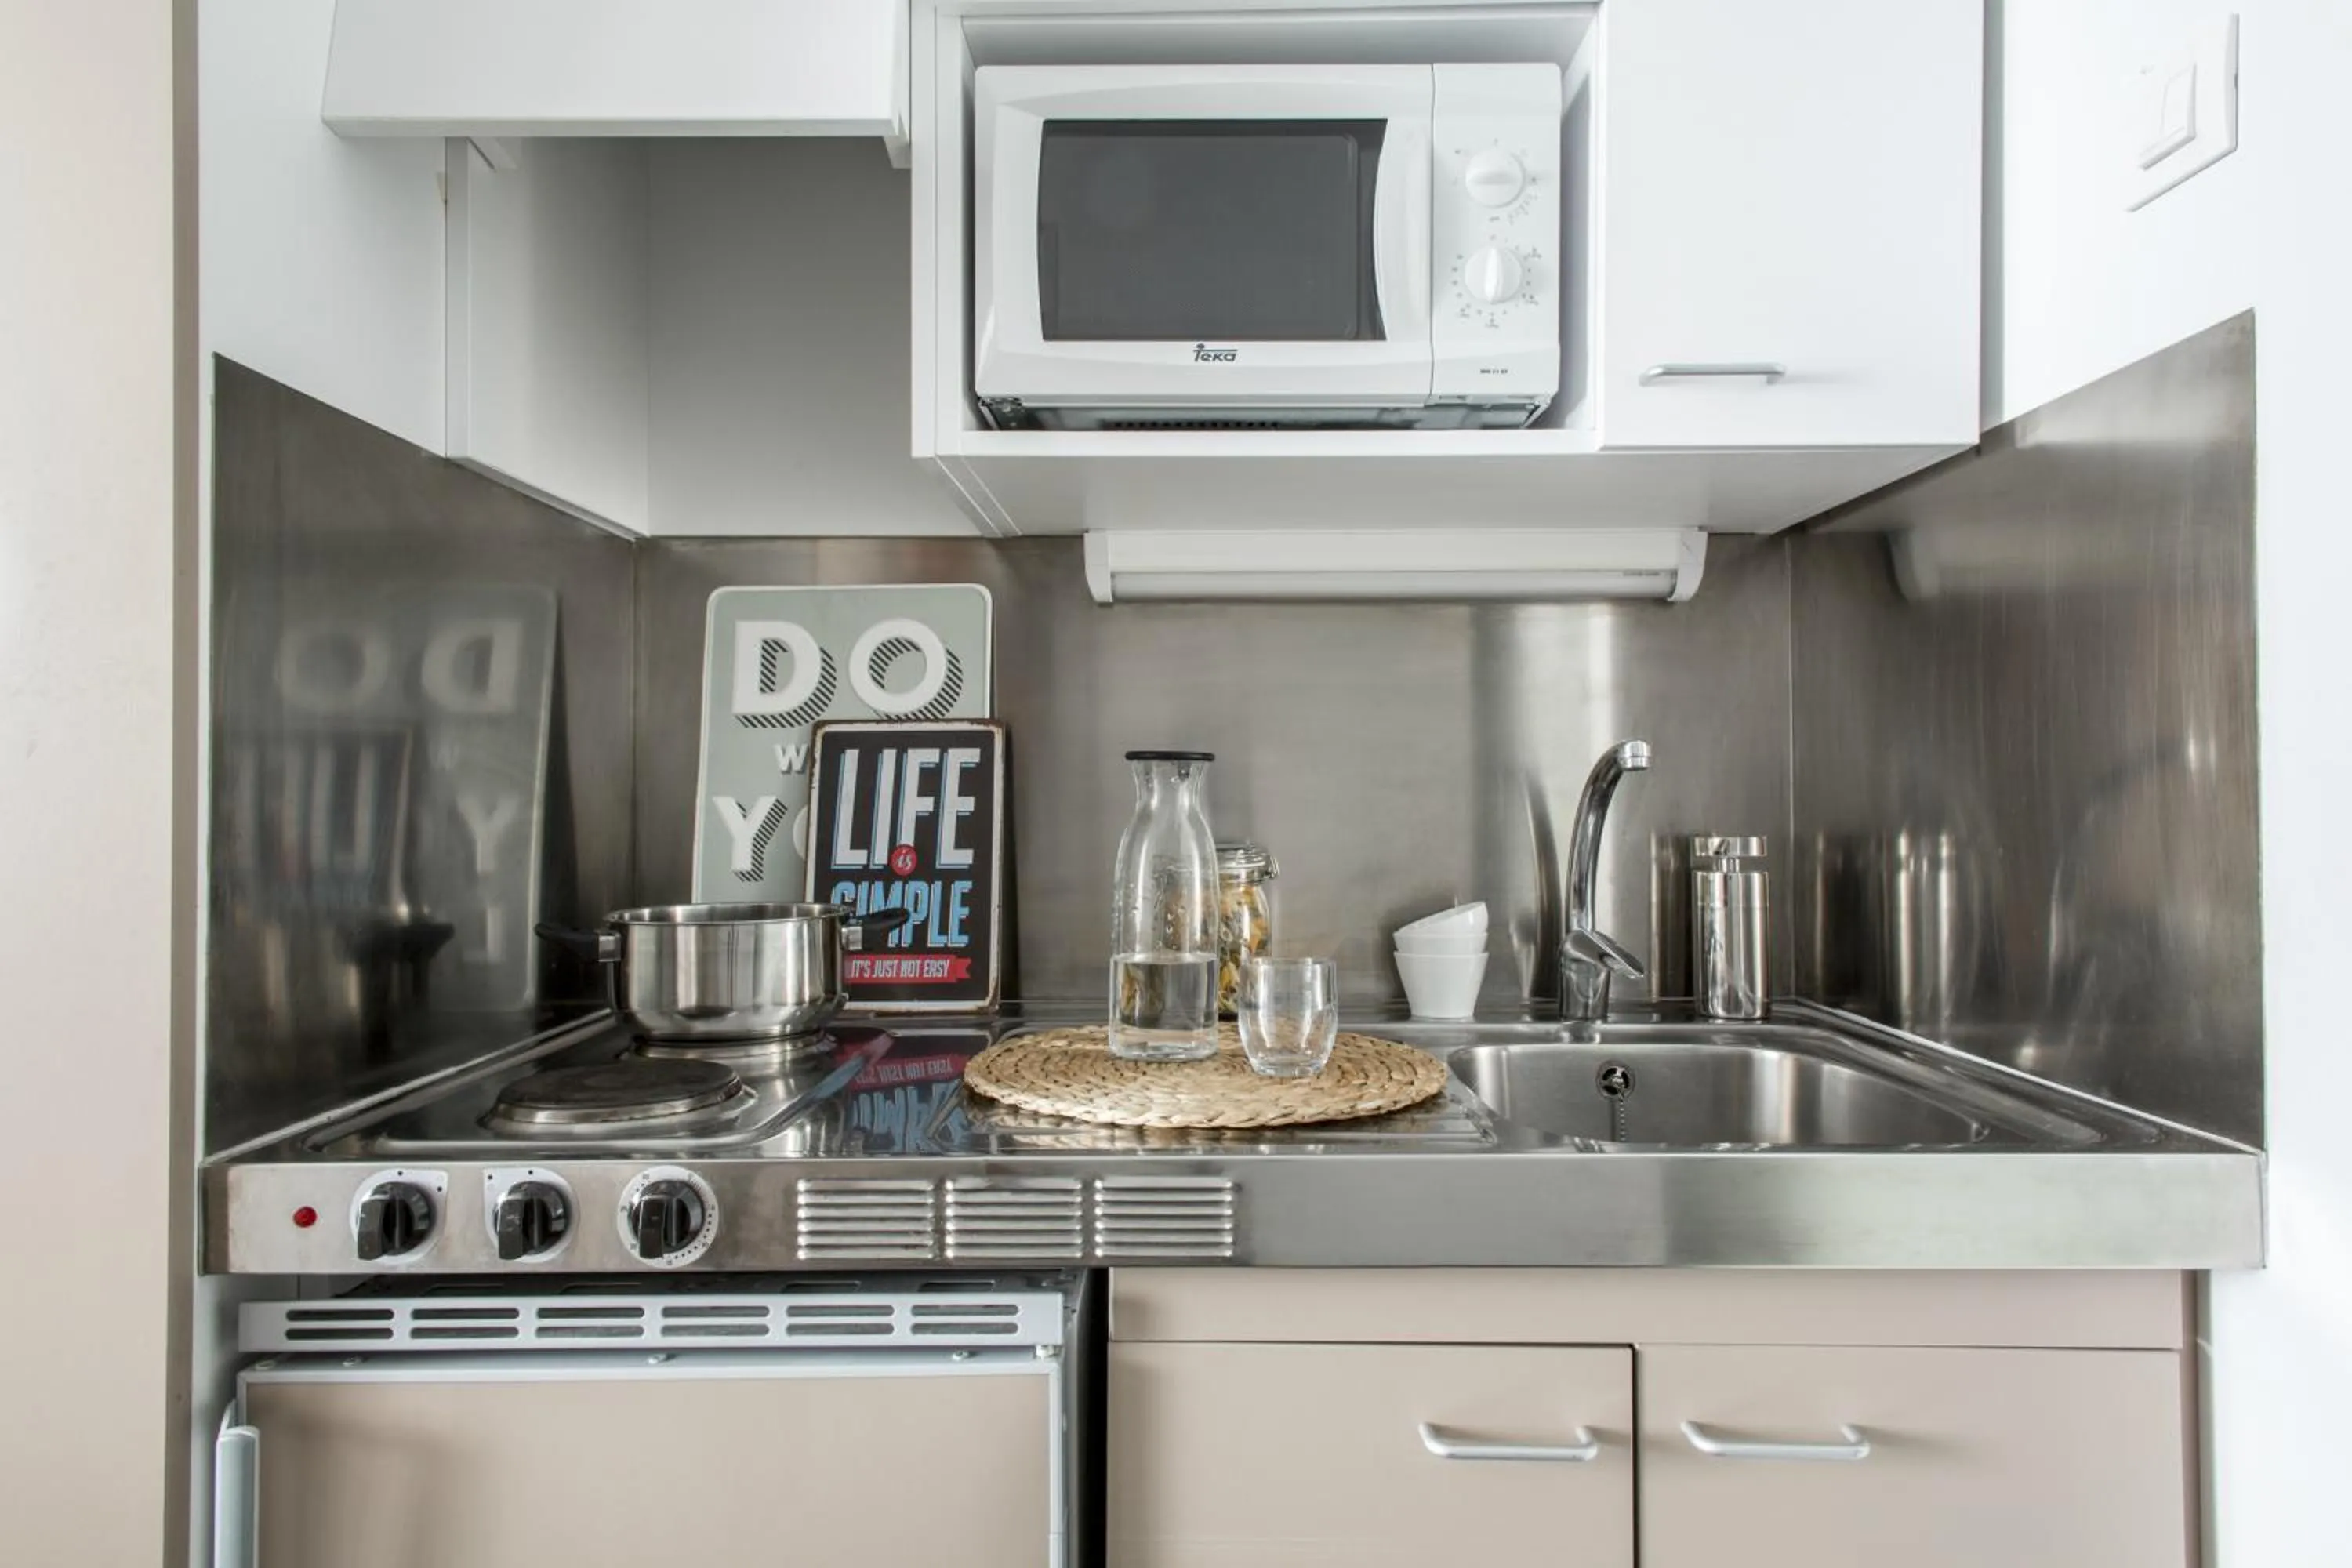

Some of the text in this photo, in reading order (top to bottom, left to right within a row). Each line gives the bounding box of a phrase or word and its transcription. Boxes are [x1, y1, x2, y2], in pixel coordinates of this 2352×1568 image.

[732, 618, 964, 727] DO
[831, 747, 981, 870] LIFE
[851, 959, 949, 978] IT'S JUST NOT EASY
